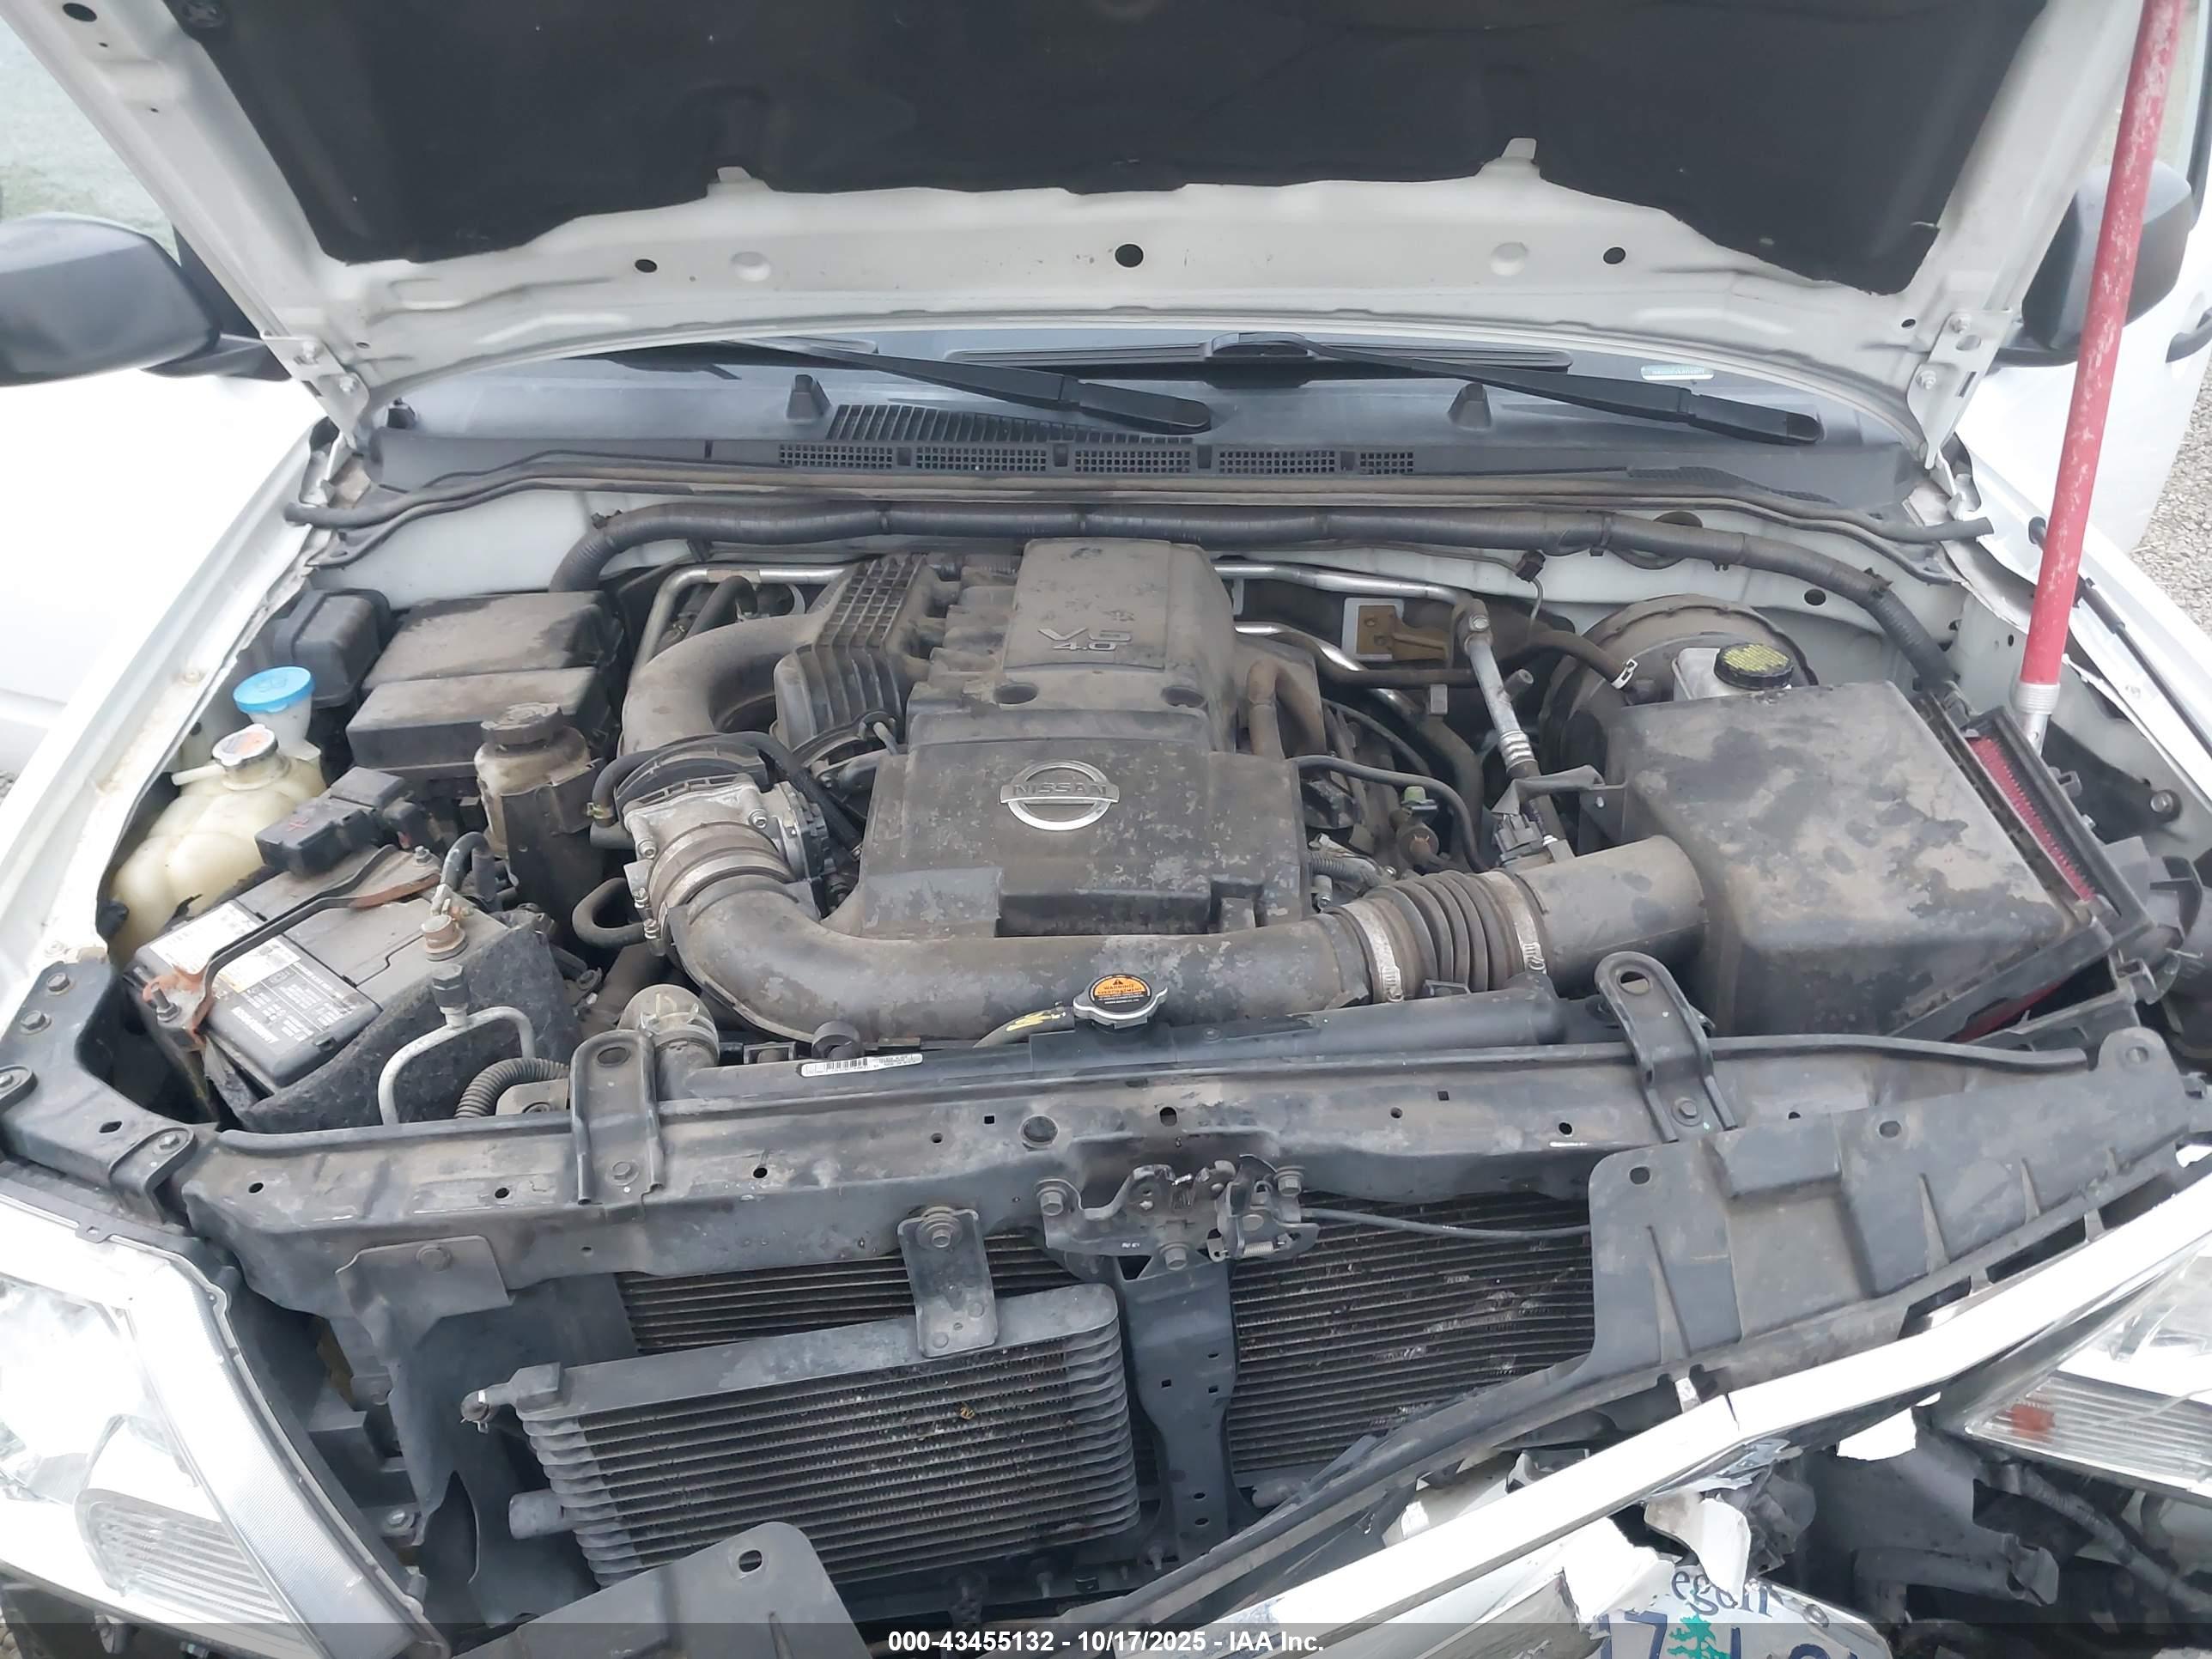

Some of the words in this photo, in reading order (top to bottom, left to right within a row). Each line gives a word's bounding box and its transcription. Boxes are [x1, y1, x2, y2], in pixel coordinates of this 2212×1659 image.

[1037, 627, 1132, 642] V6
[1052, 641, 1117, 652] 4.0
[1012, 781, 1107, 795] NISSAN
